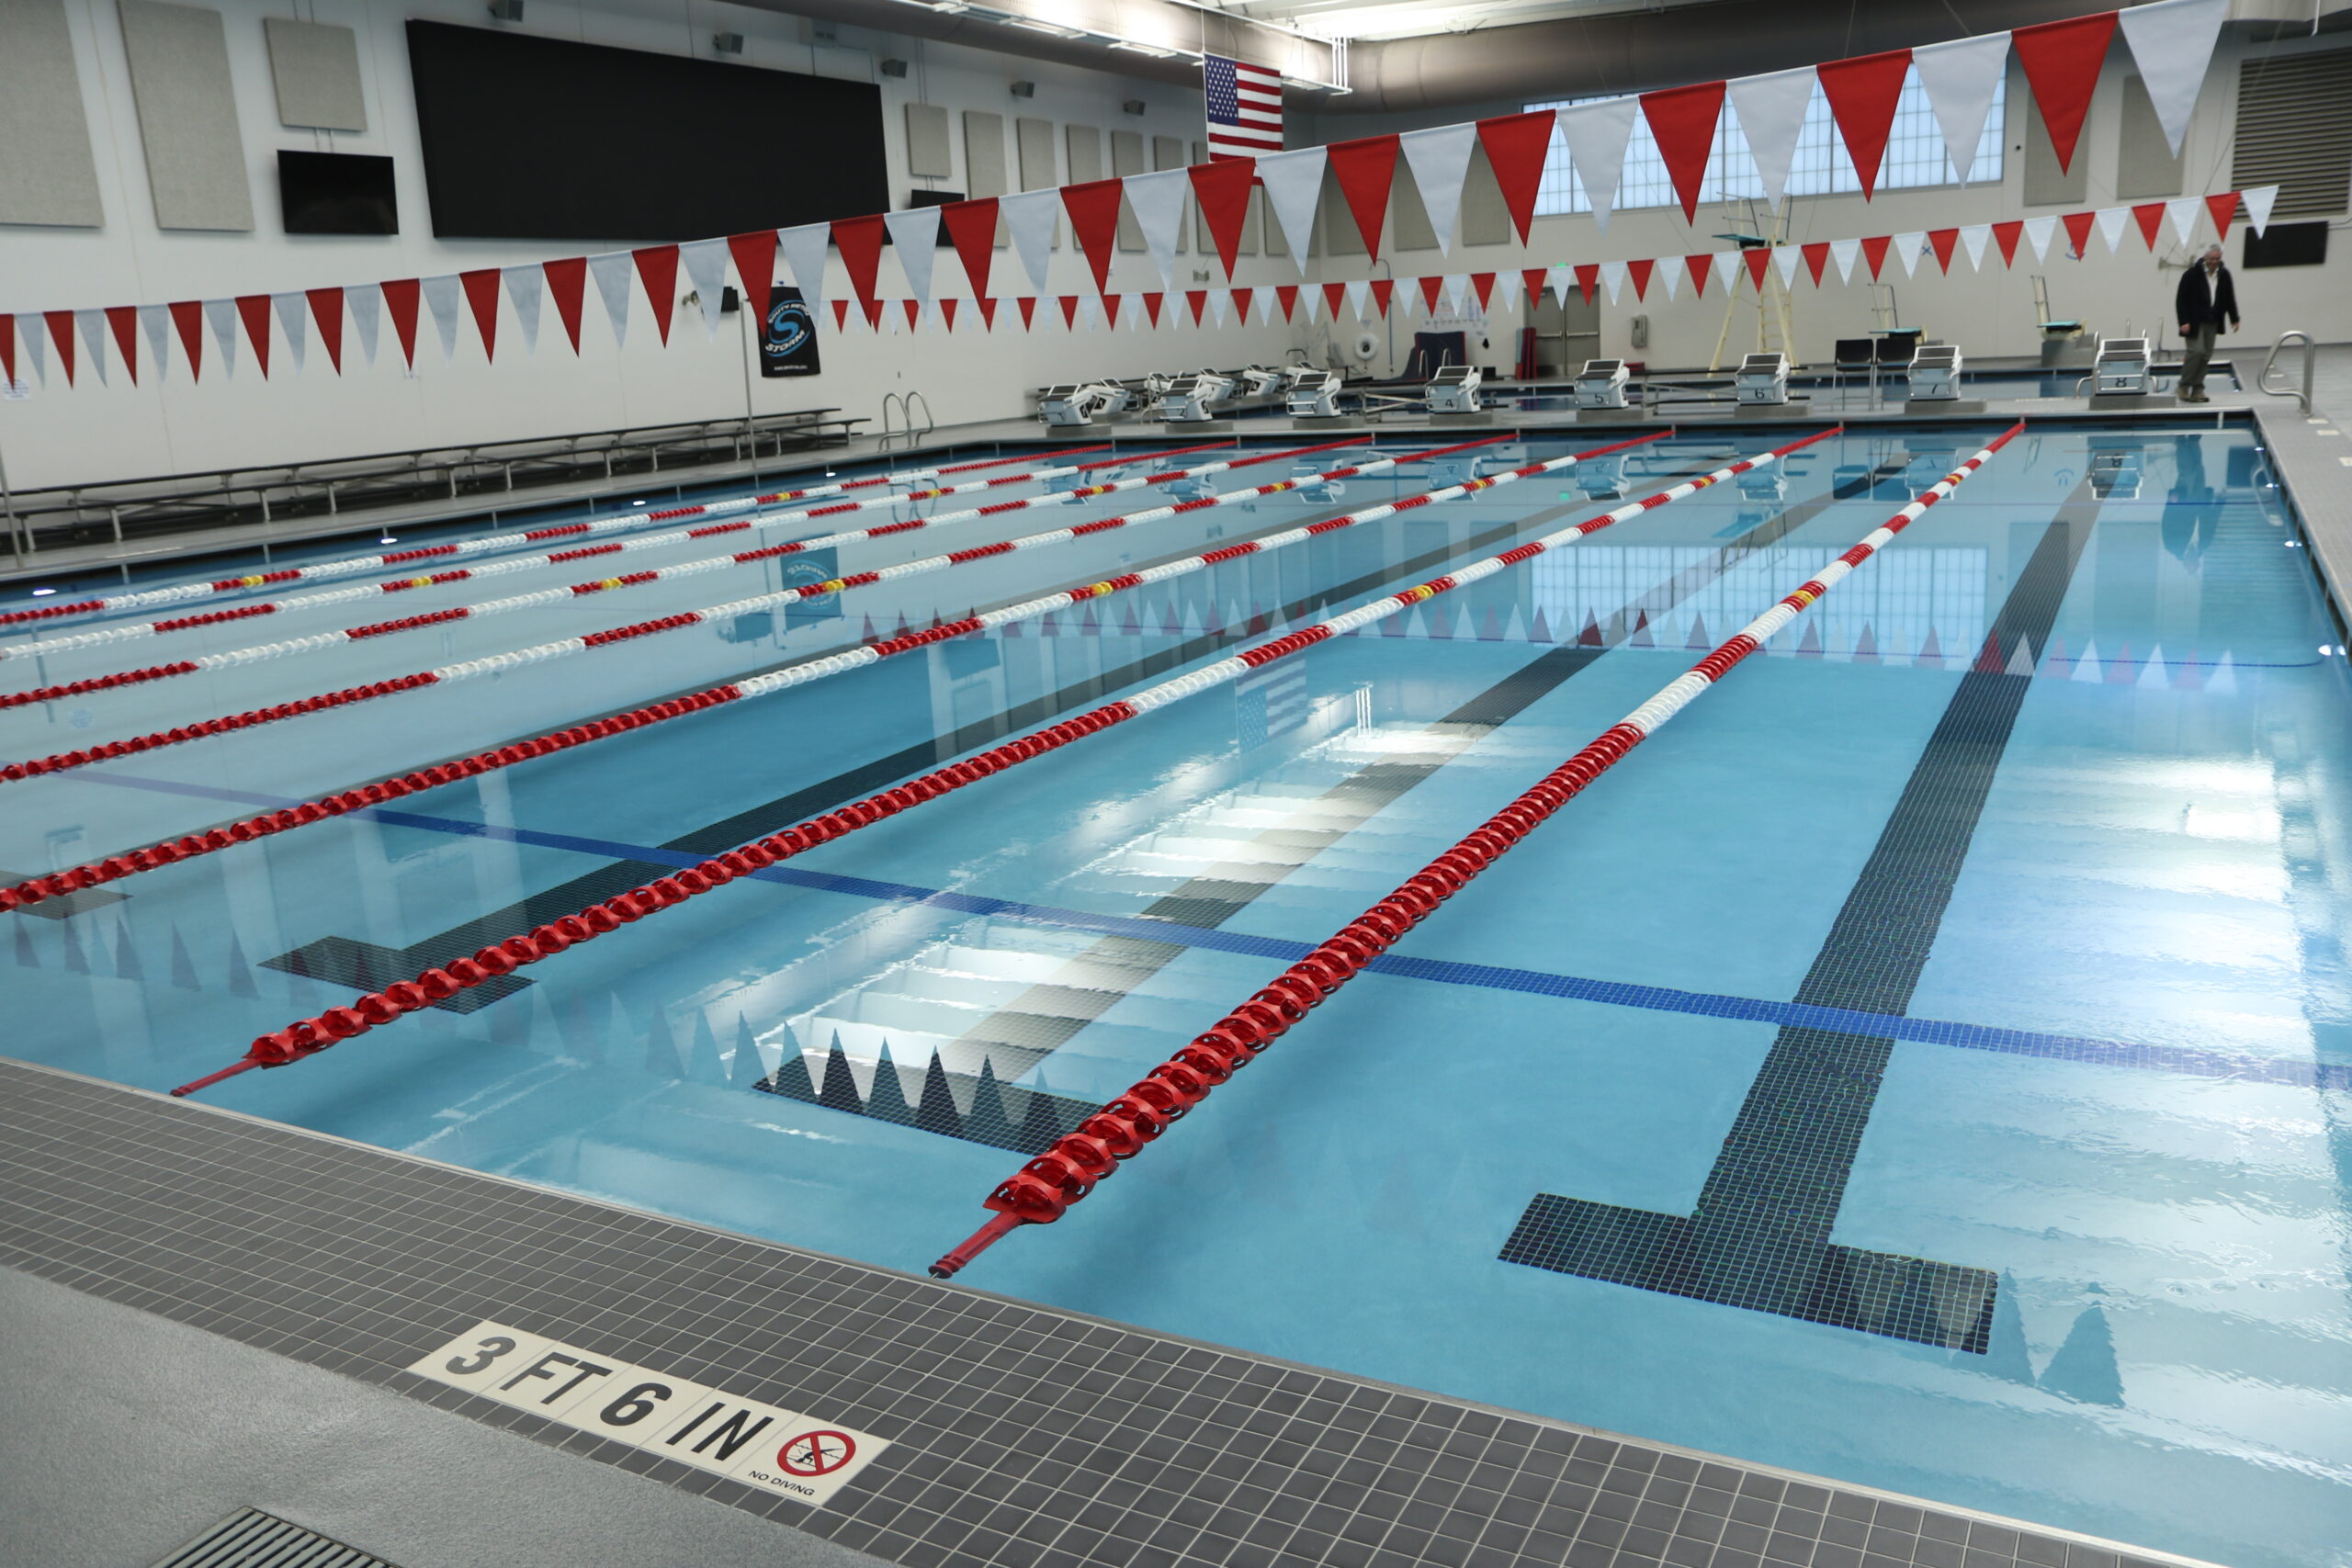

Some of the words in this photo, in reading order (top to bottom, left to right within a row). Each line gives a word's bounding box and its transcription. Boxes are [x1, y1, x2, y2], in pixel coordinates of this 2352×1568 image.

[765, 330, 805, 353] STORM
[2115, 377, 2127, 388] 8
[1594, 393, 1604, 404] 5
[1754, 389, 1765, 400] 6
[1444, 399, 1453, 409] 4
[445, 1336, 516, 1375] 3
[499, 1350, 614, 1405] FT
[599, 1382, 673, 1427] 6
[665, 1401, 775, 1462] IN
[748, 1470, 770, 1481] NO
[770, 1477, 815, 1496] DIVING
